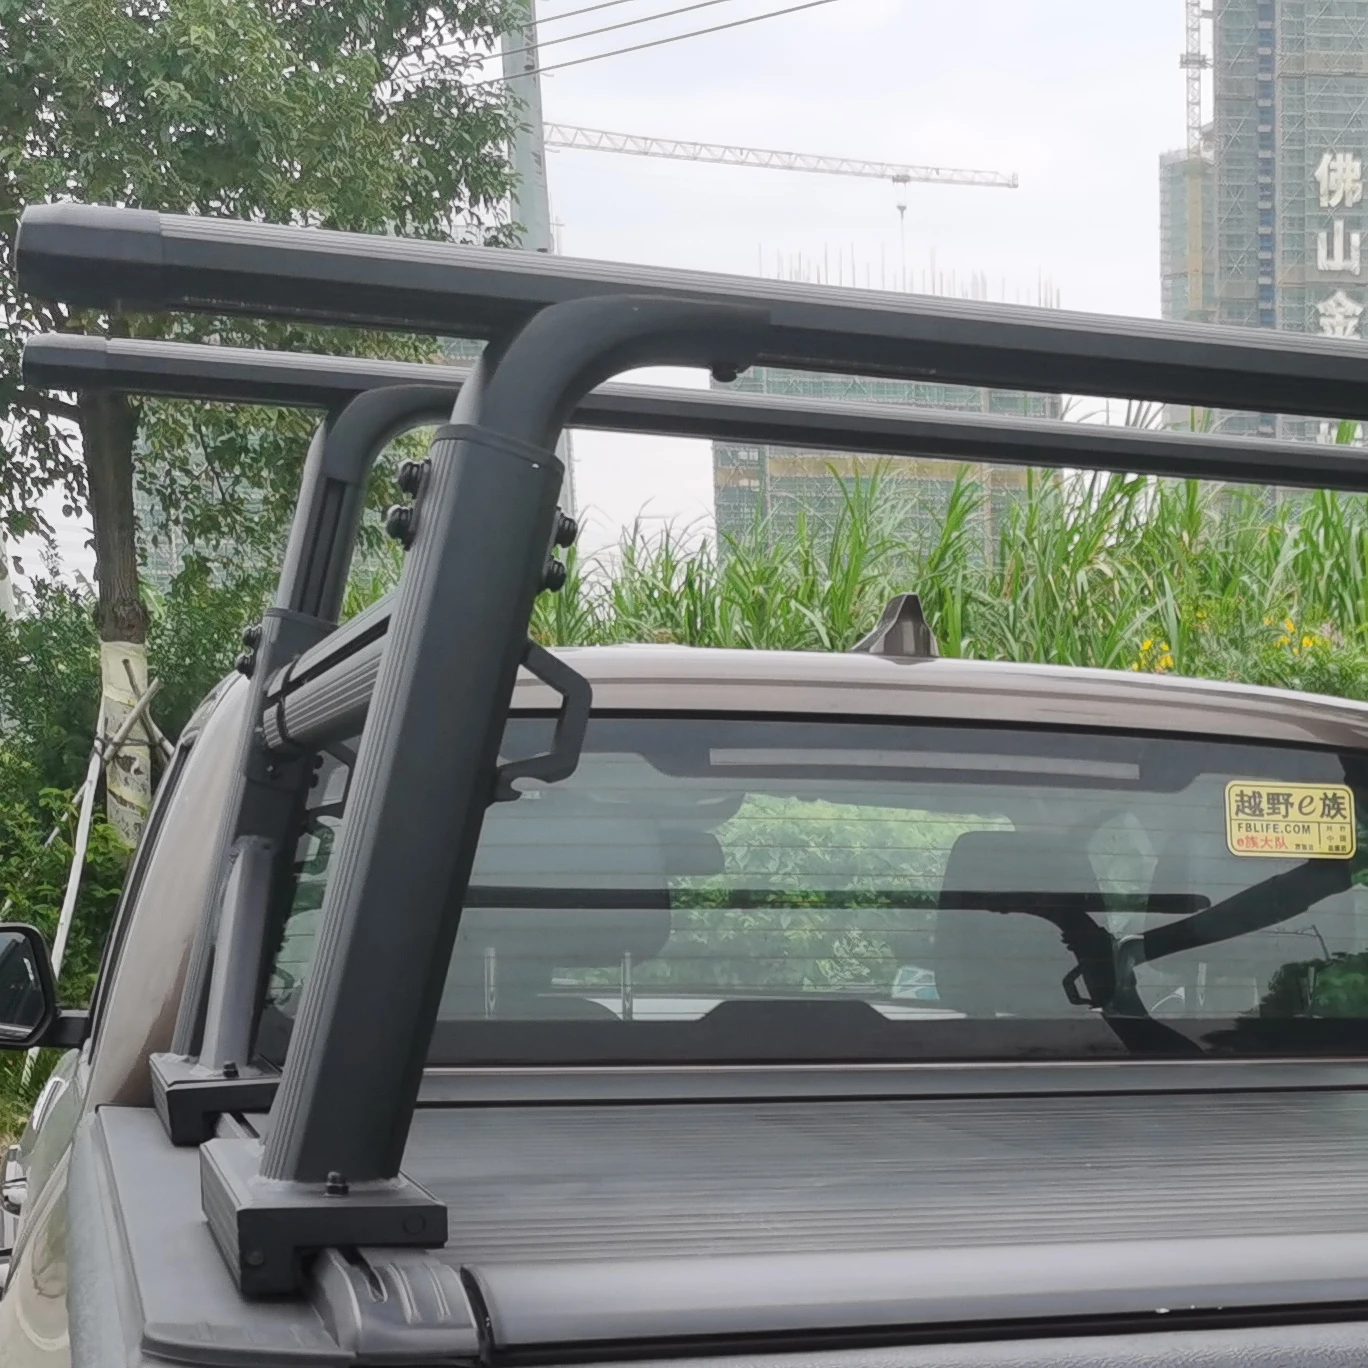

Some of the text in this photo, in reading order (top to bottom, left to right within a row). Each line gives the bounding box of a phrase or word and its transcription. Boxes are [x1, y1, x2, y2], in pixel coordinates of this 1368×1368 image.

[1314, 154, 1364, 446] 佛山金
[1235, 790, 1347, 820] 越野e族
[1237, 823, 1311, 834] FBLIFE.COM
